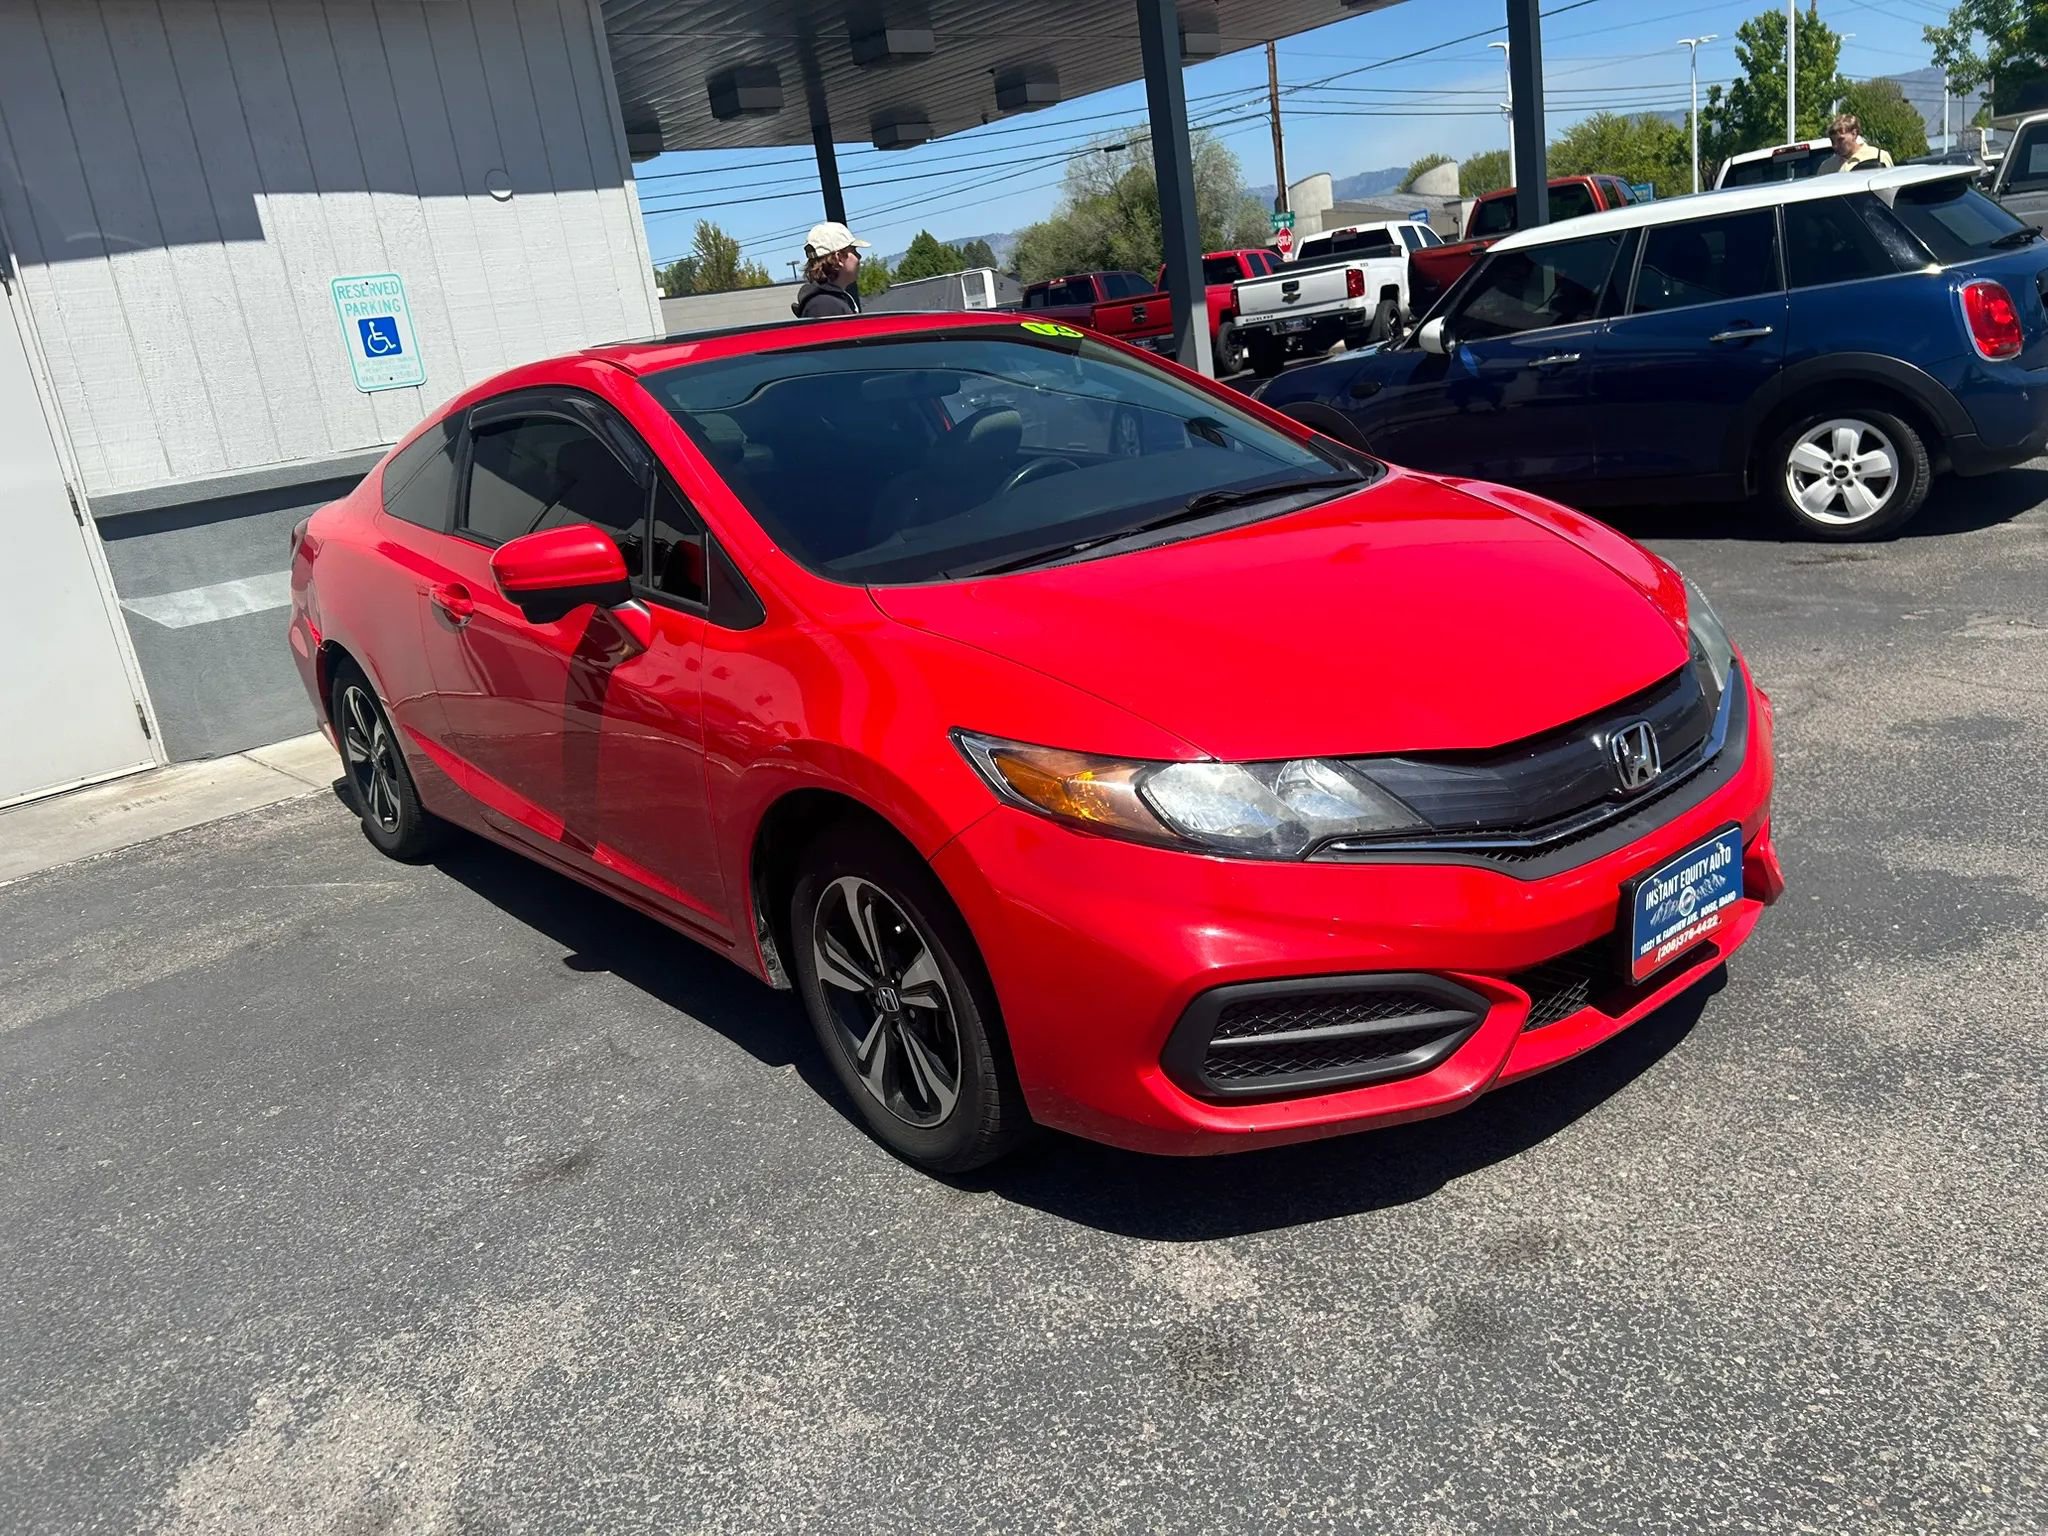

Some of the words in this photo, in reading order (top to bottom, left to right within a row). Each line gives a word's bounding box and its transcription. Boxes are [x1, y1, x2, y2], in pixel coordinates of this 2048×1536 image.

[1277, 235, 1292, 246] STOP
[336, 281, 399, 299] RESERVED
[344, 298, 401, 317] PARKING
[1645, 875, 1679, 911] INSTANT
[1680, 858, 1709, 889] EQUITY
[1710, 845, 1731, 875] AUTO
[1719, 890, 1736, 907] IDAHO
